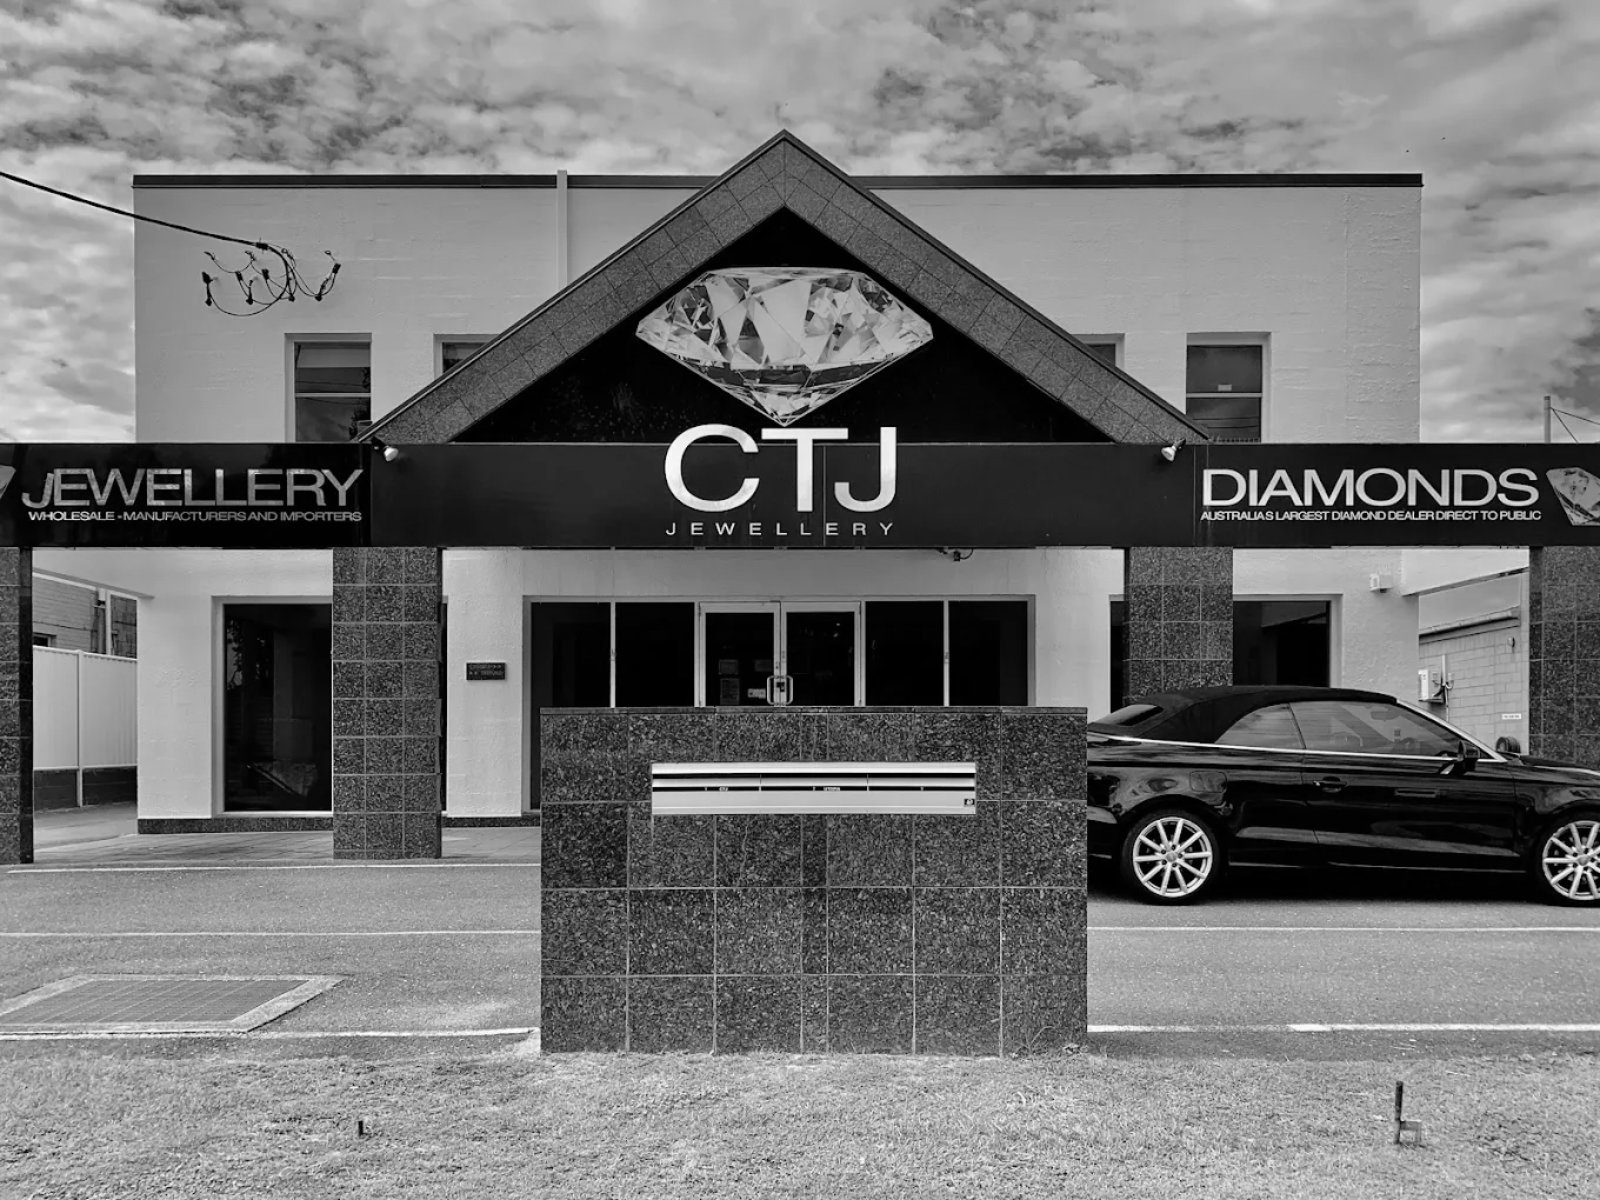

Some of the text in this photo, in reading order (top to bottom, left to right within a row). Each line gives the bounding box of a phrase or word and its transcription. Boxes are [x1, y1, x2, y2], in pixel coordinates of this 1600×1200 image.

[664, 423, 897, 512] CTJ
[21, 468, 364, 509] JEWELLERY
[1202, 467, 1539, 507] DIAMONDS
[28, 511, 115, 521] WHOLESALE
[123, 511, 247, 521] MANUFACTURERS
[247, 511, 278, 521] AND
[280, 511, 363, 522] IMPORTERS
[665, 522, 893, 536] JEWELLERY
[1275, 510, 1331, 521] LARGEST
[1331, 510, 1387, 521] DIAMOND
[1387, 510, 1435, 521] DEALER
[1435, 510, 1479, 521] DIRECT
[1480, 510, 1499, 521] TO
[1499, 510, 1542, 521] PUBLIC
